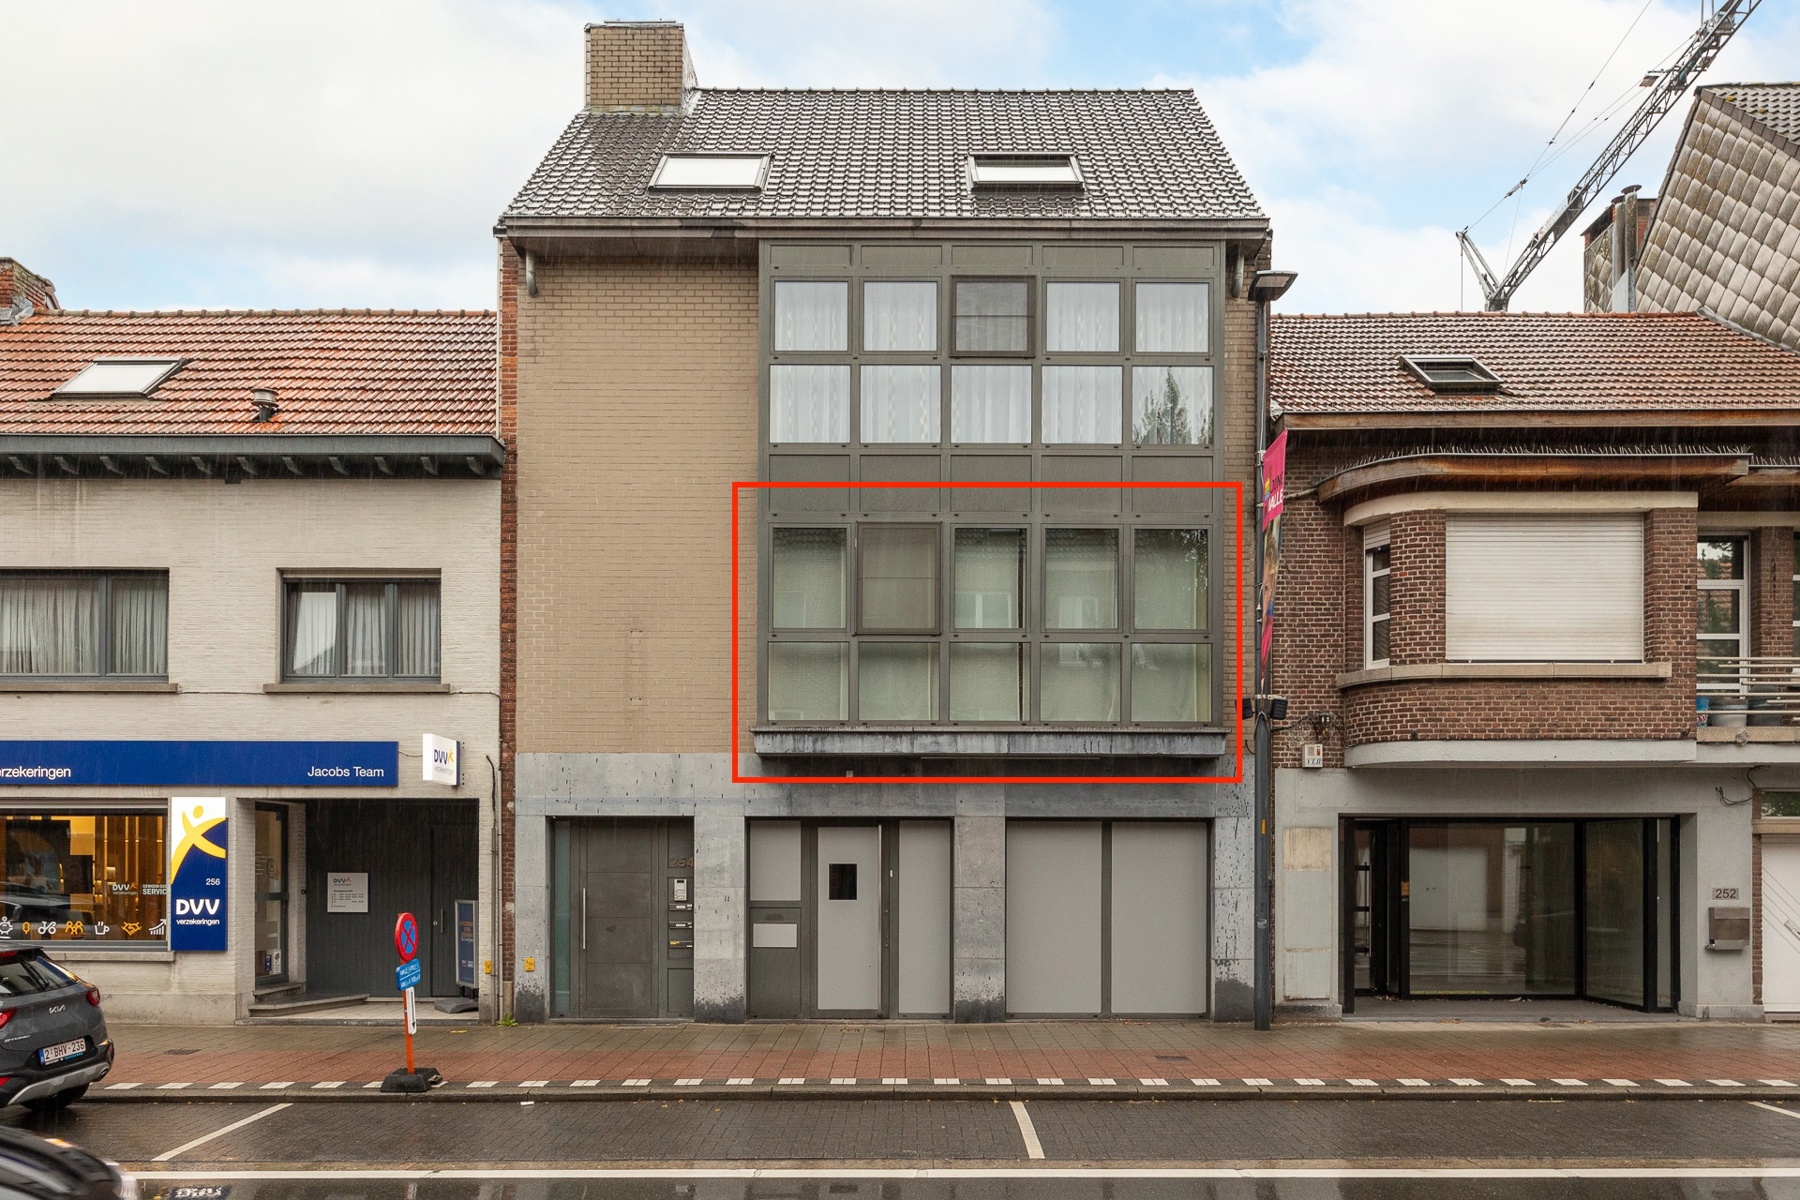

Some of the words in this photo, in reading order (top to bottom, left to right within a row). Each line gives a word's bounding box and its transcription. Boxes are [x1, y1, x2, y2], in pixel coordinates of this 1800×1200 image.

[433, 749, 449, 765] DVV
[0, 765, 72, 780] rzekeringen
[307, 766, 350, 777] Jacobs
[353, 766, 385, 777] Team
[670, 857, 694, 868] 254
[205, 878, 221, 886] 256
[1715, 888, 1737, 899] 252
[175, 899, 220, 915] DVV
[176, 918, 220, 926] verzekeringen
